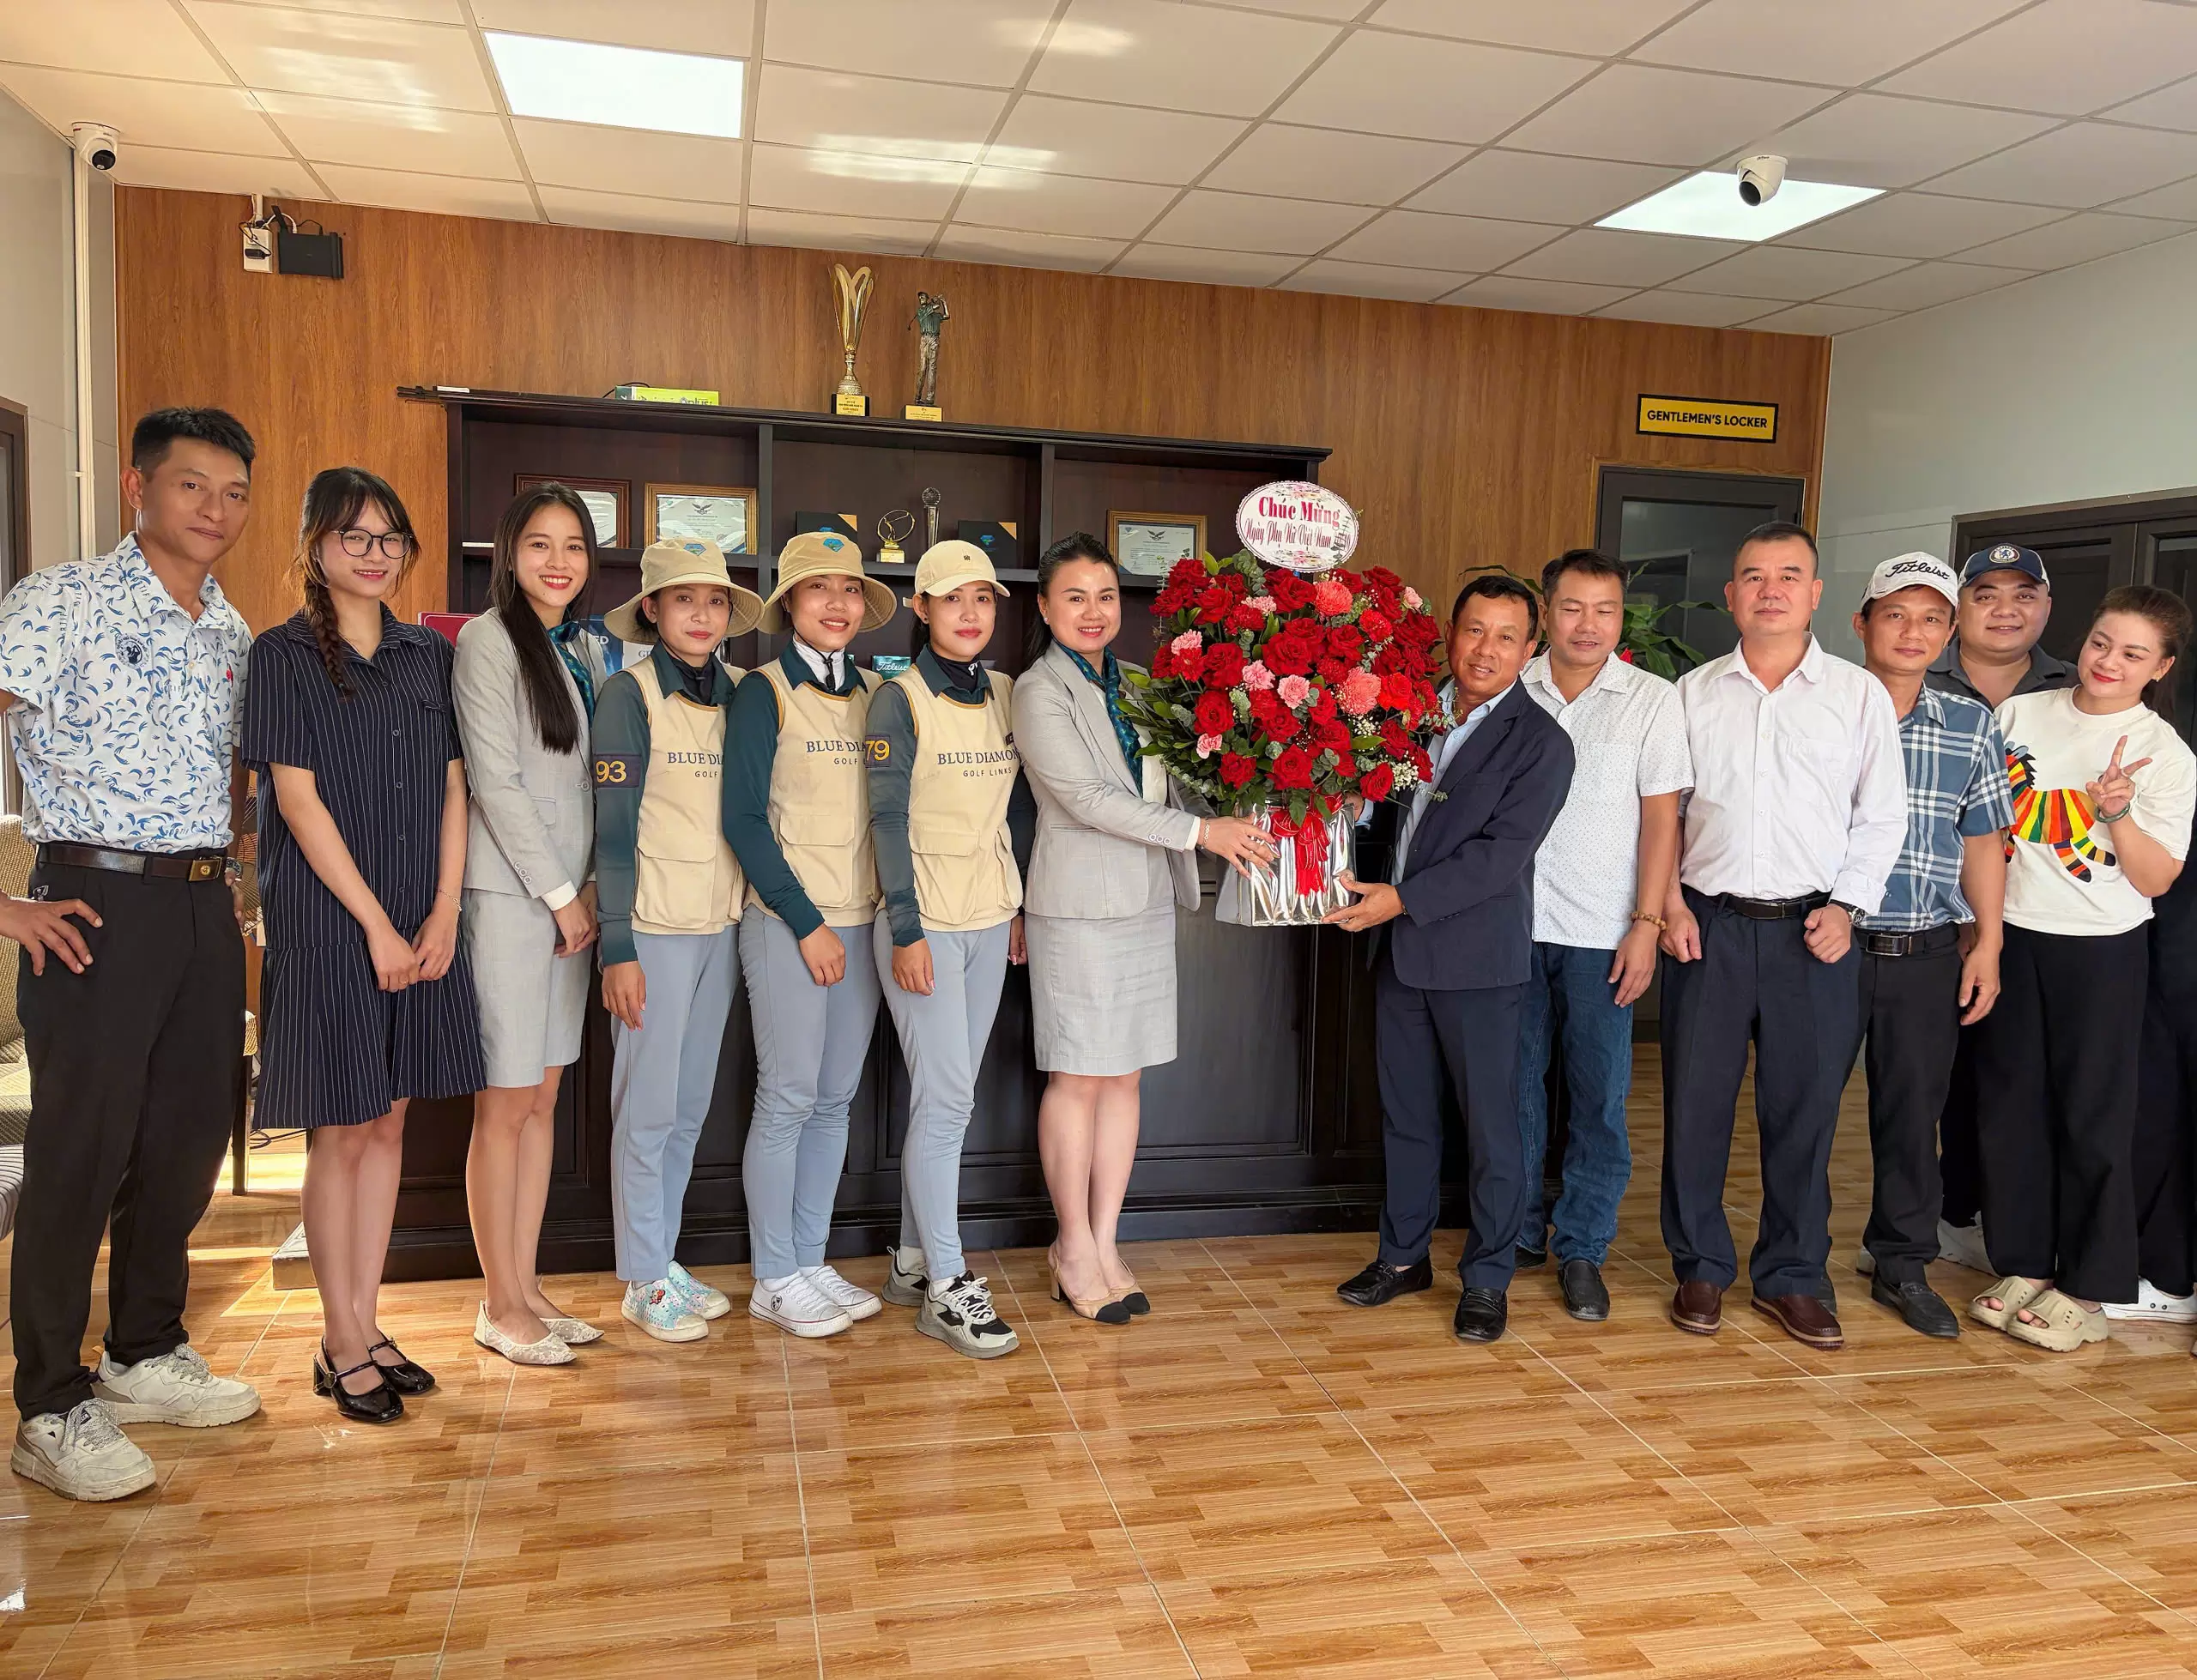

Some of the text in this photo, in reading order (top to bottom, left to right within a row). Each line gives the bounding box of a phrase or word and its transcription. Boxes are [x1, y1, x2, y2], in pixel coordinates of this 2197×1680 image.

[1647, 410, 1768, 428] GENTLEMEN'S LOCKER
[1258, 496, 1341, 530] Chúc Mừng
[1244, 518, 1264, 545] Ngày
[1885, 560, 1951, 580] Titleist
[875, 662, 909, 672] Titleist
[806, 740, 844, 752] BLUE
[865, 740, 890, 761] 79
[667, 752, 724, 764] BLUE DI
[937, 749, 1020, 764] BLUE DIAMON
[596, 760, 627, 783] 93
[989, 767, 1012, 777] LINKS
